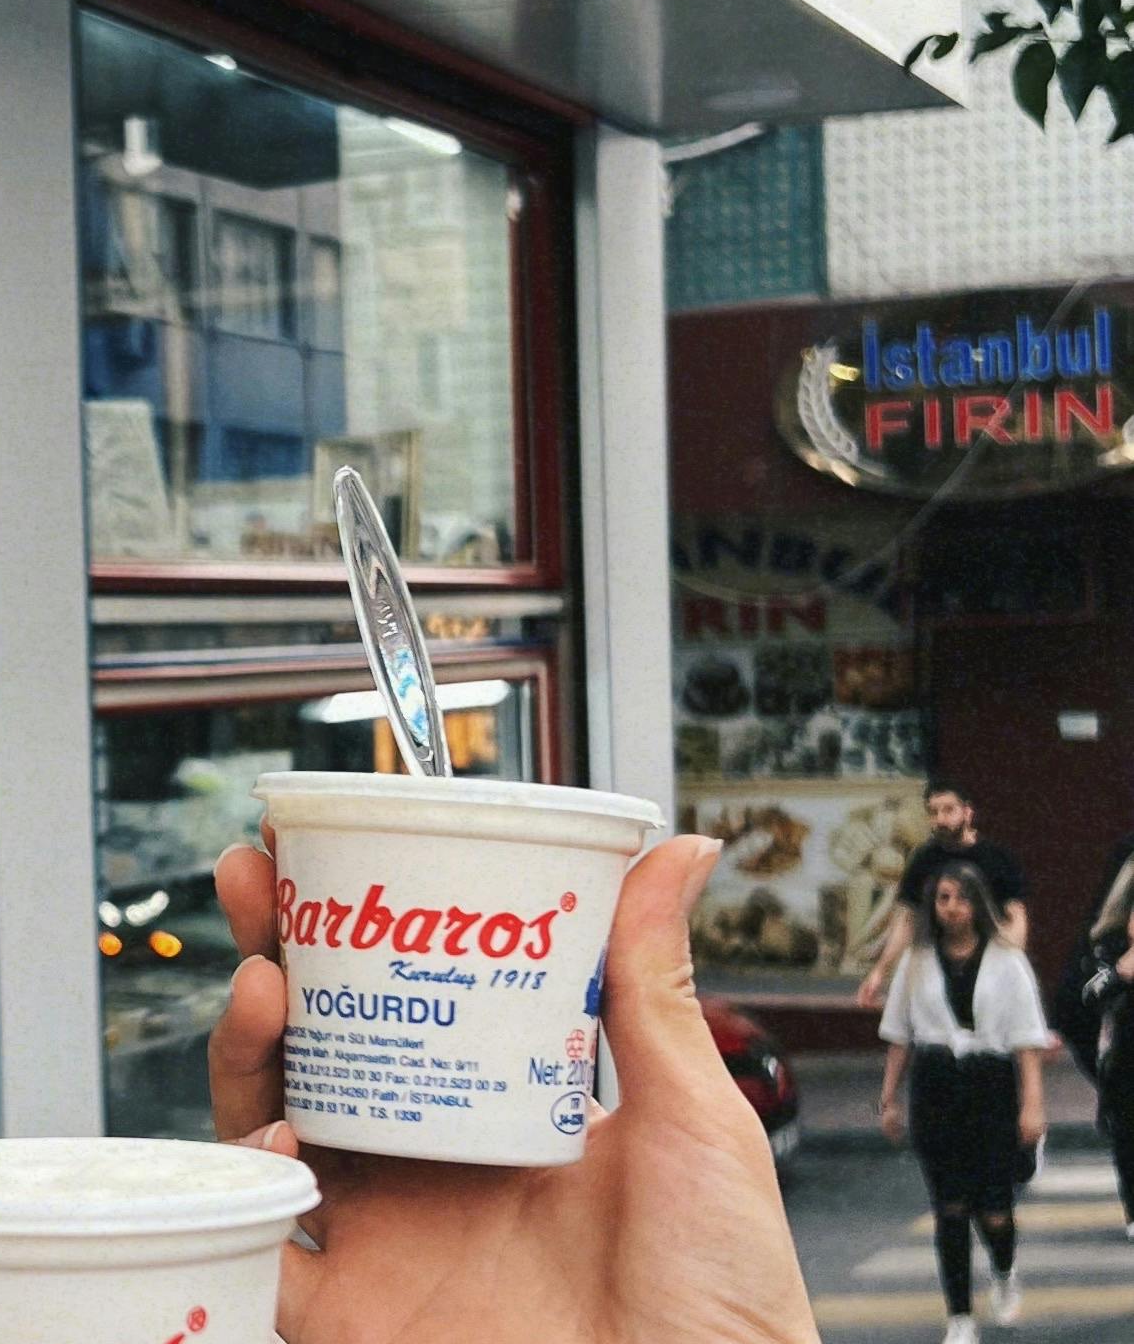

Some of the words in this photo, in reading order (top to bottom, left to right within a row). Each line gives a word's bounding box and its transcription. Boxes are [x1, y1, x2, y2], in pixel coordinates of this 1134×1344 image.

[864, 380, 1115, 452] FIRIN
[277, 877, 559, 960] Barbaros
[387, 960, 477, 991] Kuruluş
[488, 968, 548, 991] 1918
[301, 985, 457, 1027] YOĞURDU
[408, 1090, 473, 1108] İSTANBUL
